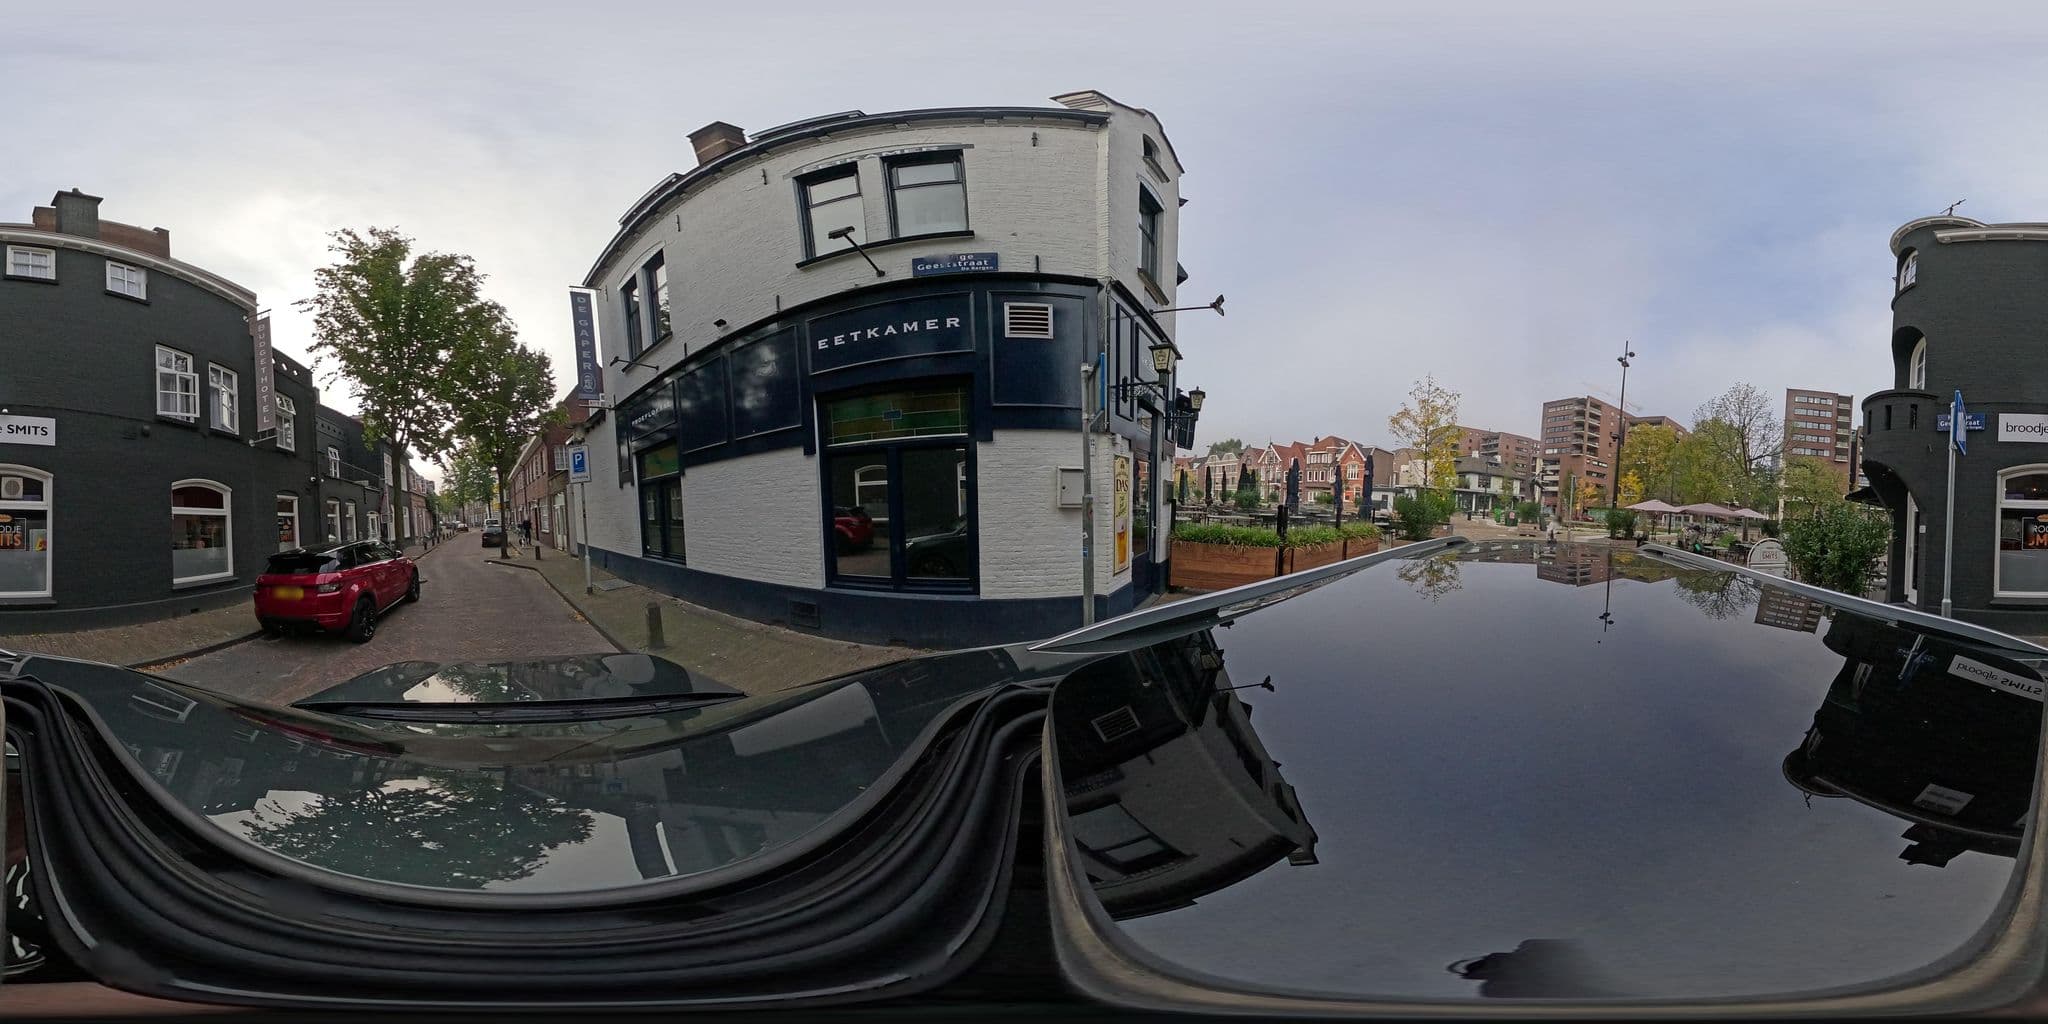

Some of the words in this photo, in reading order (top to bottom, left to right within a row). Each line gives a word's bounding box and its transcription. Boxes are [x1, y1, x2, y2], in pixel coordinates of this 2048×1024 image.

[817, 317, 961, 350] EETKAMER
[578, 319, 592, 370] GAPER
[7, 424, 48, 436] SMITS
[574, 453, 583, 465] P
[1115, 479, 1129, 492] DAS
